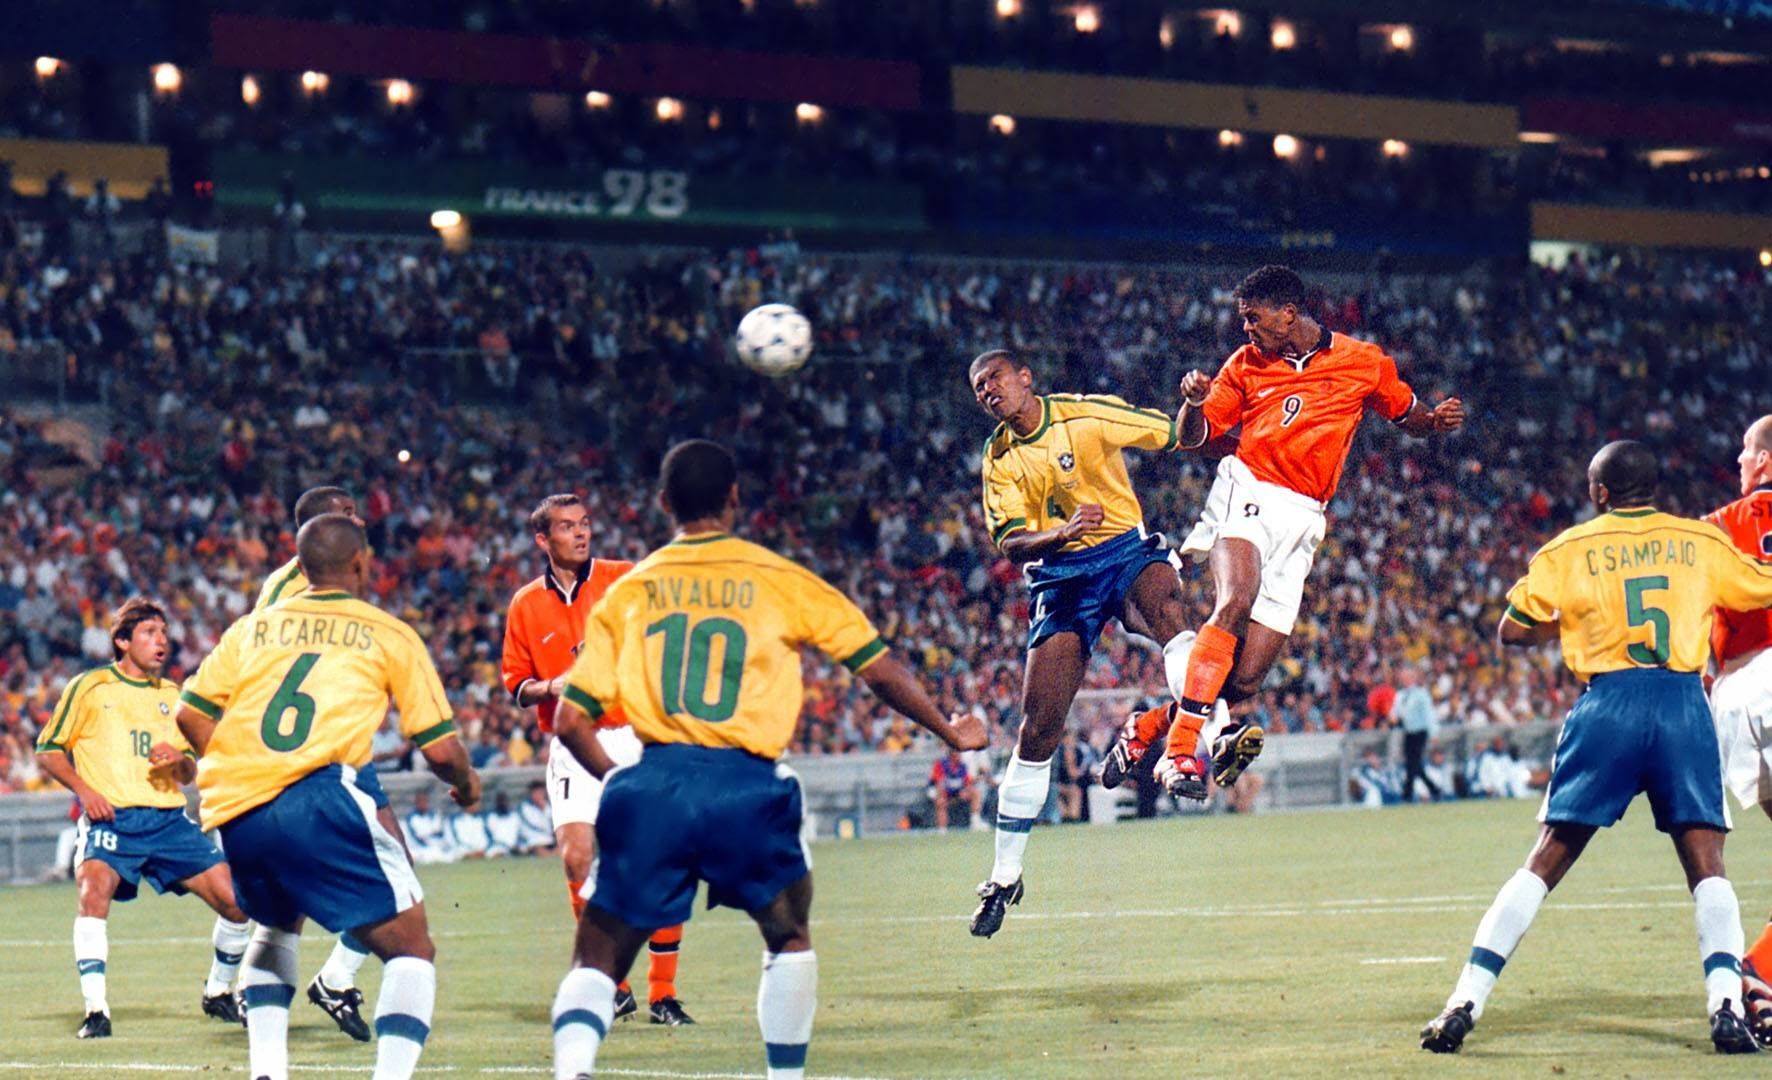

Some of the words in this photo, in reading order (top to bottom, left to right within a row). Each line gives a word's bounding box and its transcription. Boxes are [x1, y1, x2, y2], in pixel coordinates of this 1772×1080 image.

[484, 187, 599, 215] FRANCE
[603, 168, 688, 219] 98
[1280, 395, 1303, 428] 9
[644, 575, 754, 609] RIVALDO
[1624, 575, 1671, 665] 5
[645, 611, 747, 722] 10
[260, 652, 322, 753] 6
[130, 729, 152, 758] 18
[90, 829, 118, 851] 18
